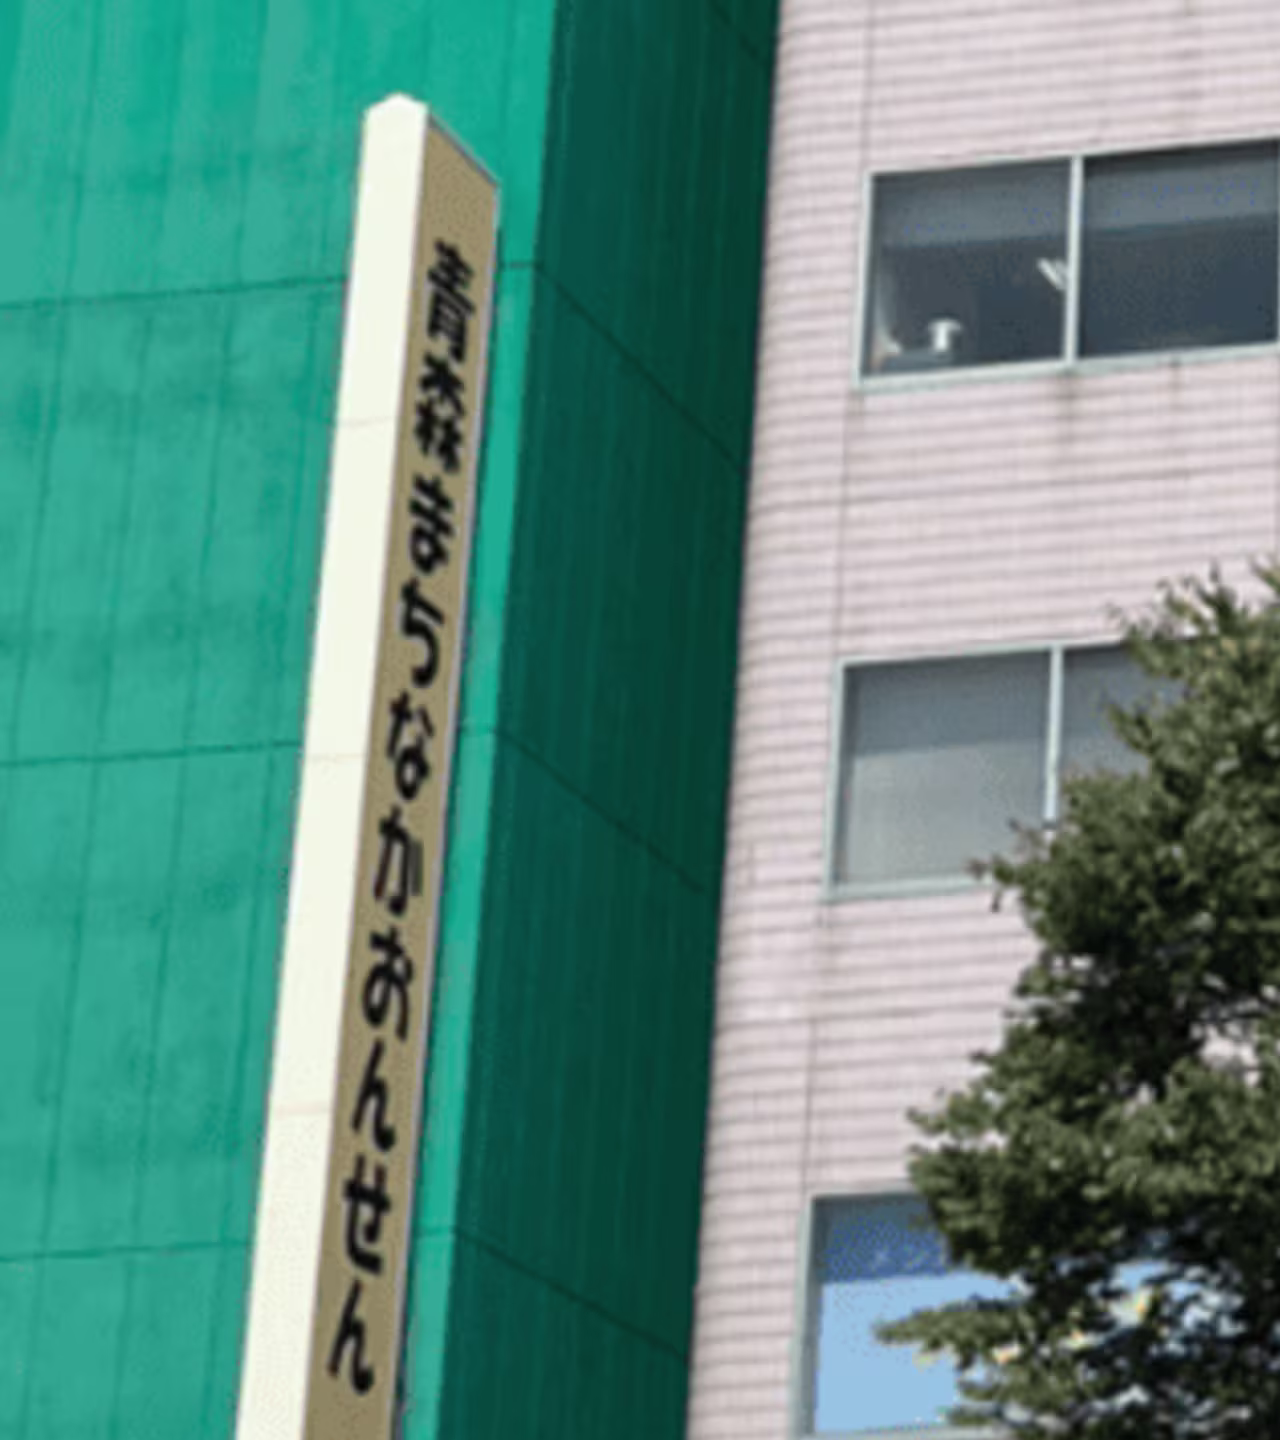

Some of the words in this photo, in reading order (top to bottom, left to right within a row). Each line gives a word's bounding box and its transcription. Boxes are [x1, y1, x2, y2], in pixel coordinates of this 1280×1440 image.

[328, 239, 475, 1394] 青森まちなかおんせん
